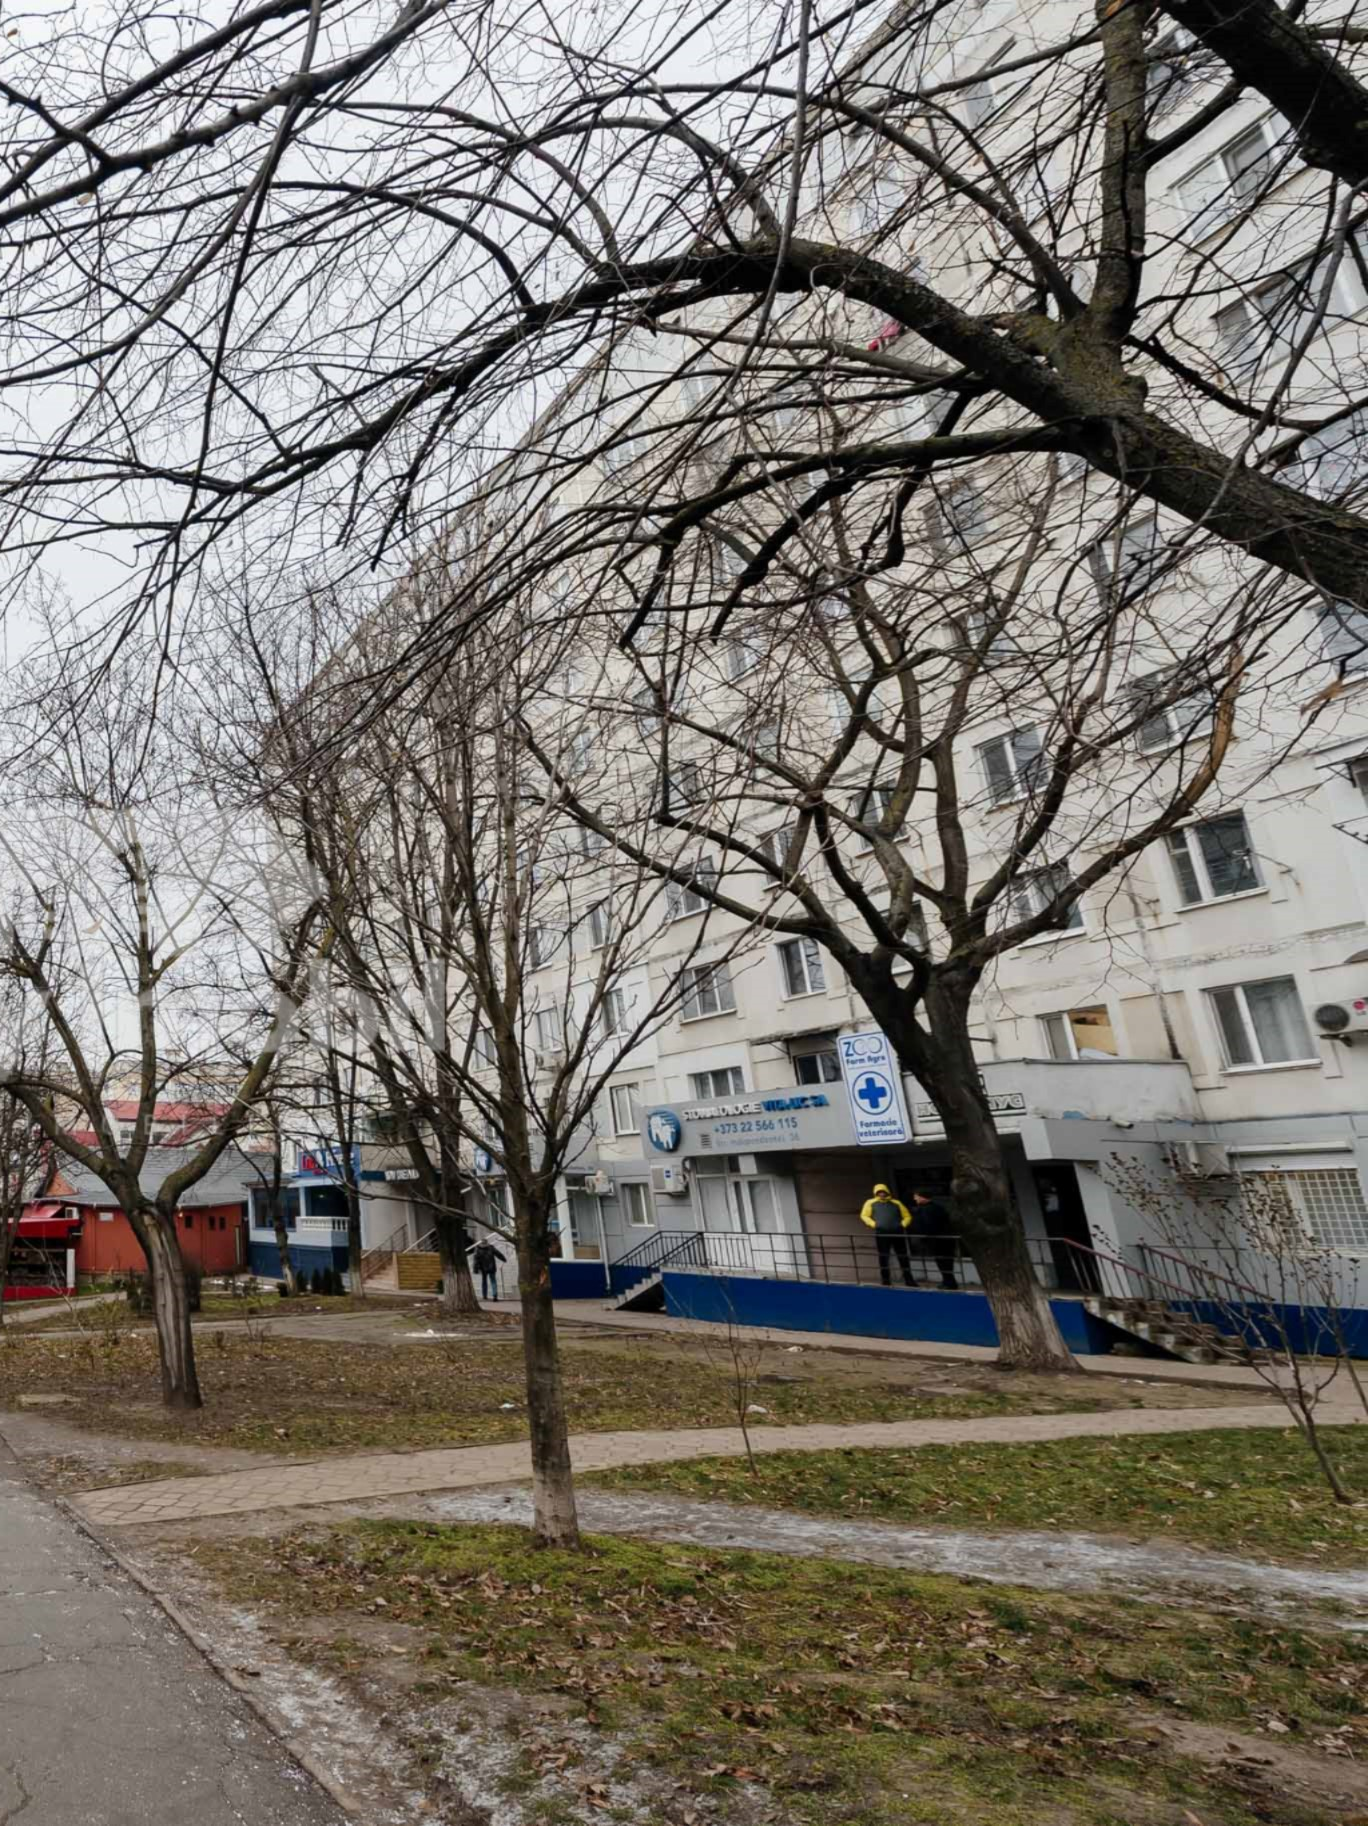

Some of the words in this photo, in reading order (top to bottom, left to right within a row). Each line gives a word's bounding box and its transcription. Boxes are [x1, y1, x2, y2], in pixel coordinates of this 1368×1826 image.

[714, 1123, 738, 1135] +373
[740, 1121, 753, 1133] 22
[755, 1119, 775, 1131] 566
[777, 1116, 798, 1128] 115
